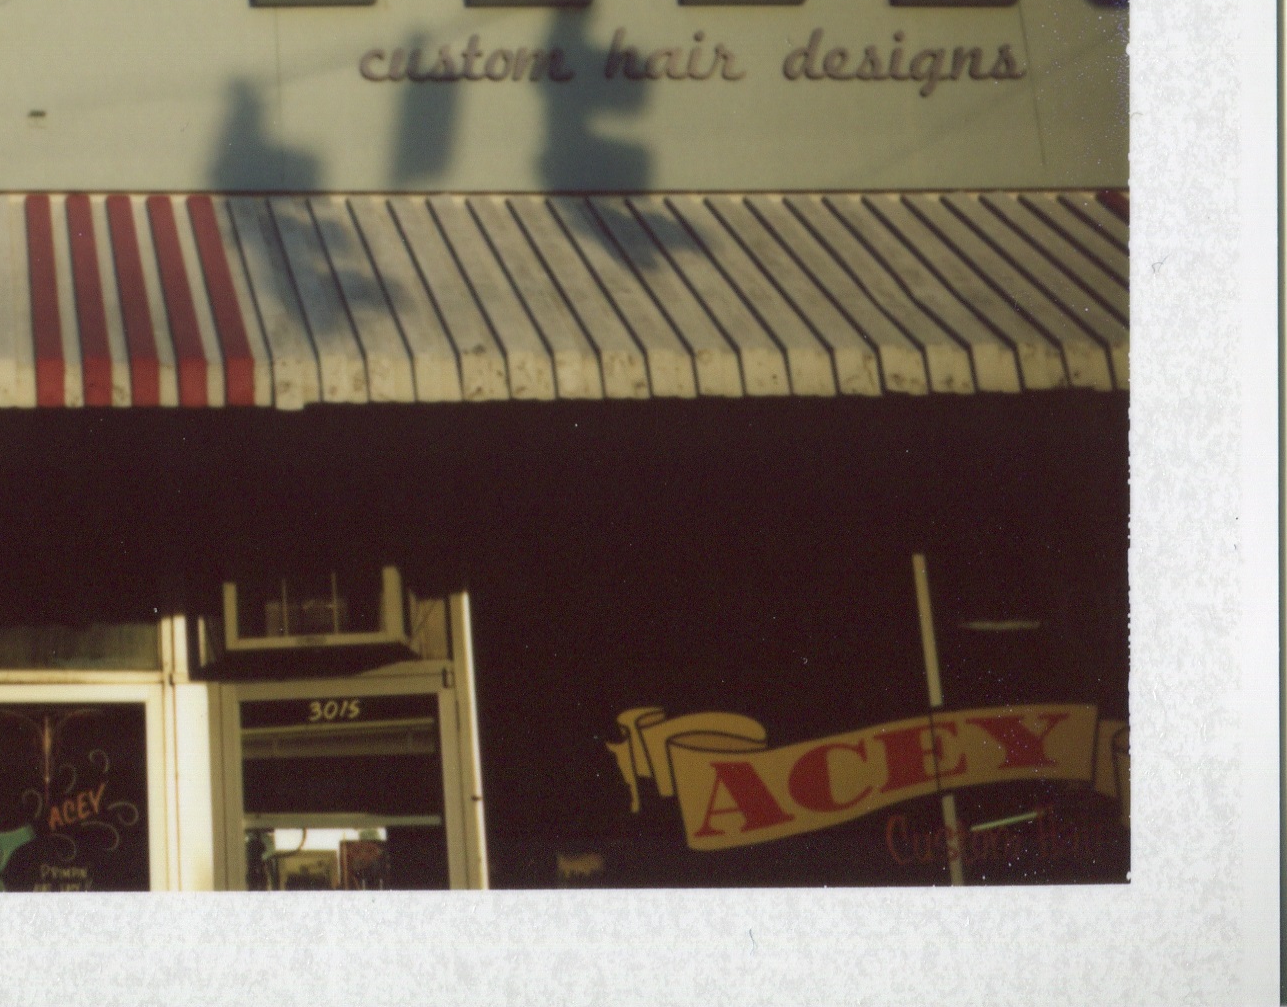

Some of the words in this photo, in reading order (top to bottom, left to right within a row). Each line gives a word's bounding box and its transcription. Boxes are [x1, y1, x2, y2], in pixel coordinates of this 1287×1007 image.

[359, 32, 574, 83] custom
[602, 27, 747, 81] hair
[782, 27, 1027, 97] designs
[307, 699, 362, 723] 3015
[693, 713, 1072, 838] ACEY
[47, 782, 106, 832] ACEY
